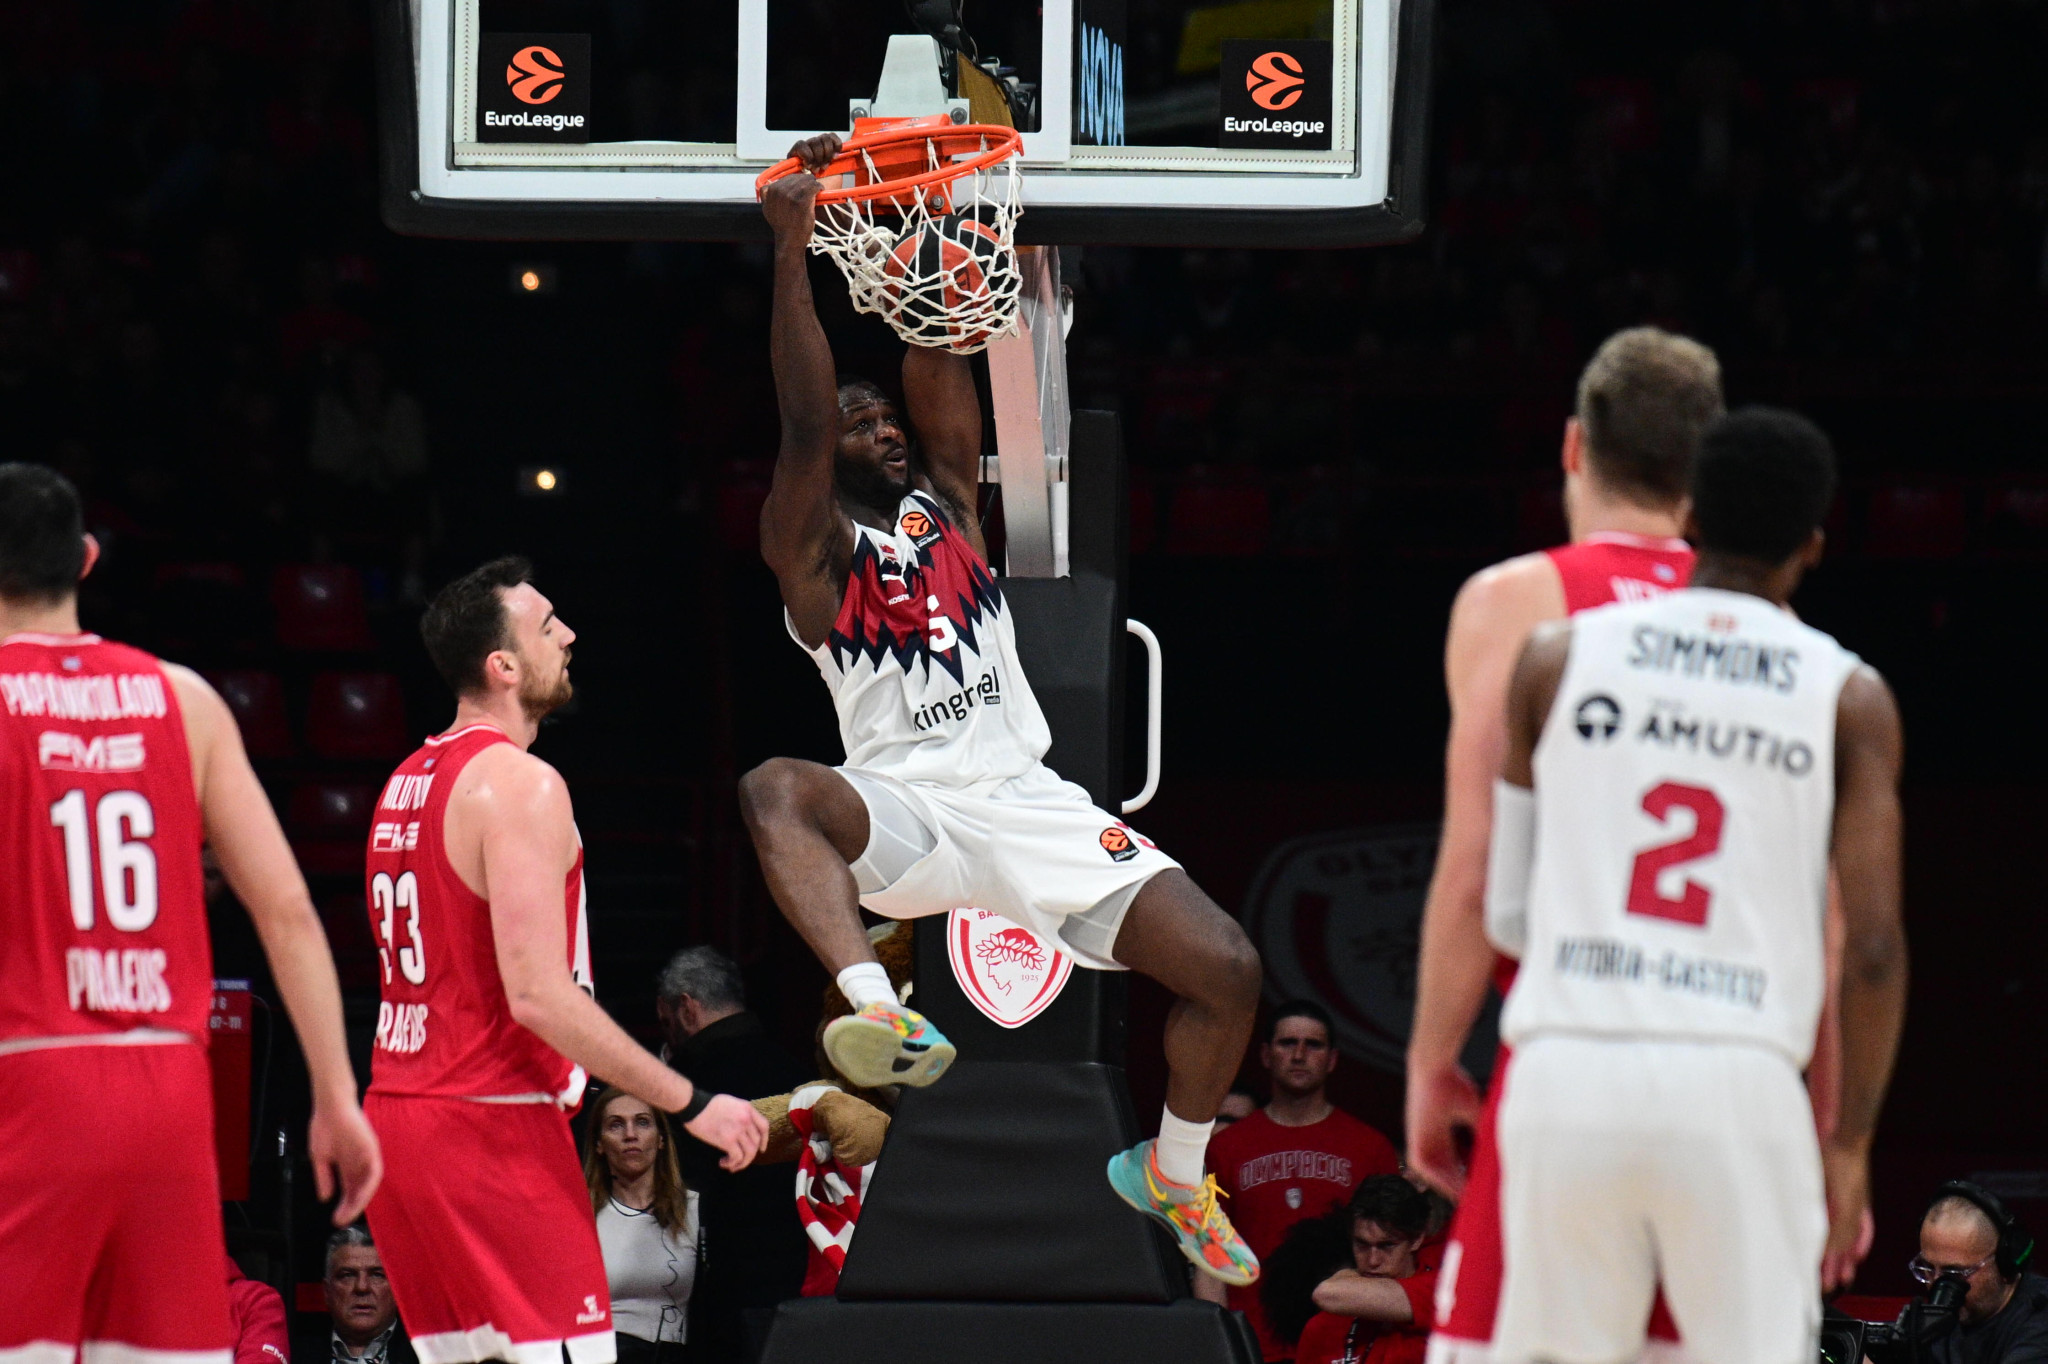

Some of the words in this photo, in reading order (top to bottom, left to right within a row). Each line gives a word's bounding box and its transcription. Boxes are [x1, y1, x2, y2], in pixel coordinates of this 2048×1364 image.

[1080, 21, 1125, 146] NOVA
[484, 110, 585, 131] EuroLeague
[1224, 116, 1325, 137] EuroLeague
[927, 594, 959, 653] 5
[1628, 623, 1800, 693] SIMMONS
[38, 731, 147, 774] FMS
[1639, 713, 1815, 778] AMUTIO
[51, 788, 158, 933] 16
[1625, 779, 1727, 928] 2
[371, 871, 427, 986] 33
[1021, 974, 1040, 983] 1925
[1239, 1149, 1353, 1191] OLYMPIACOS
